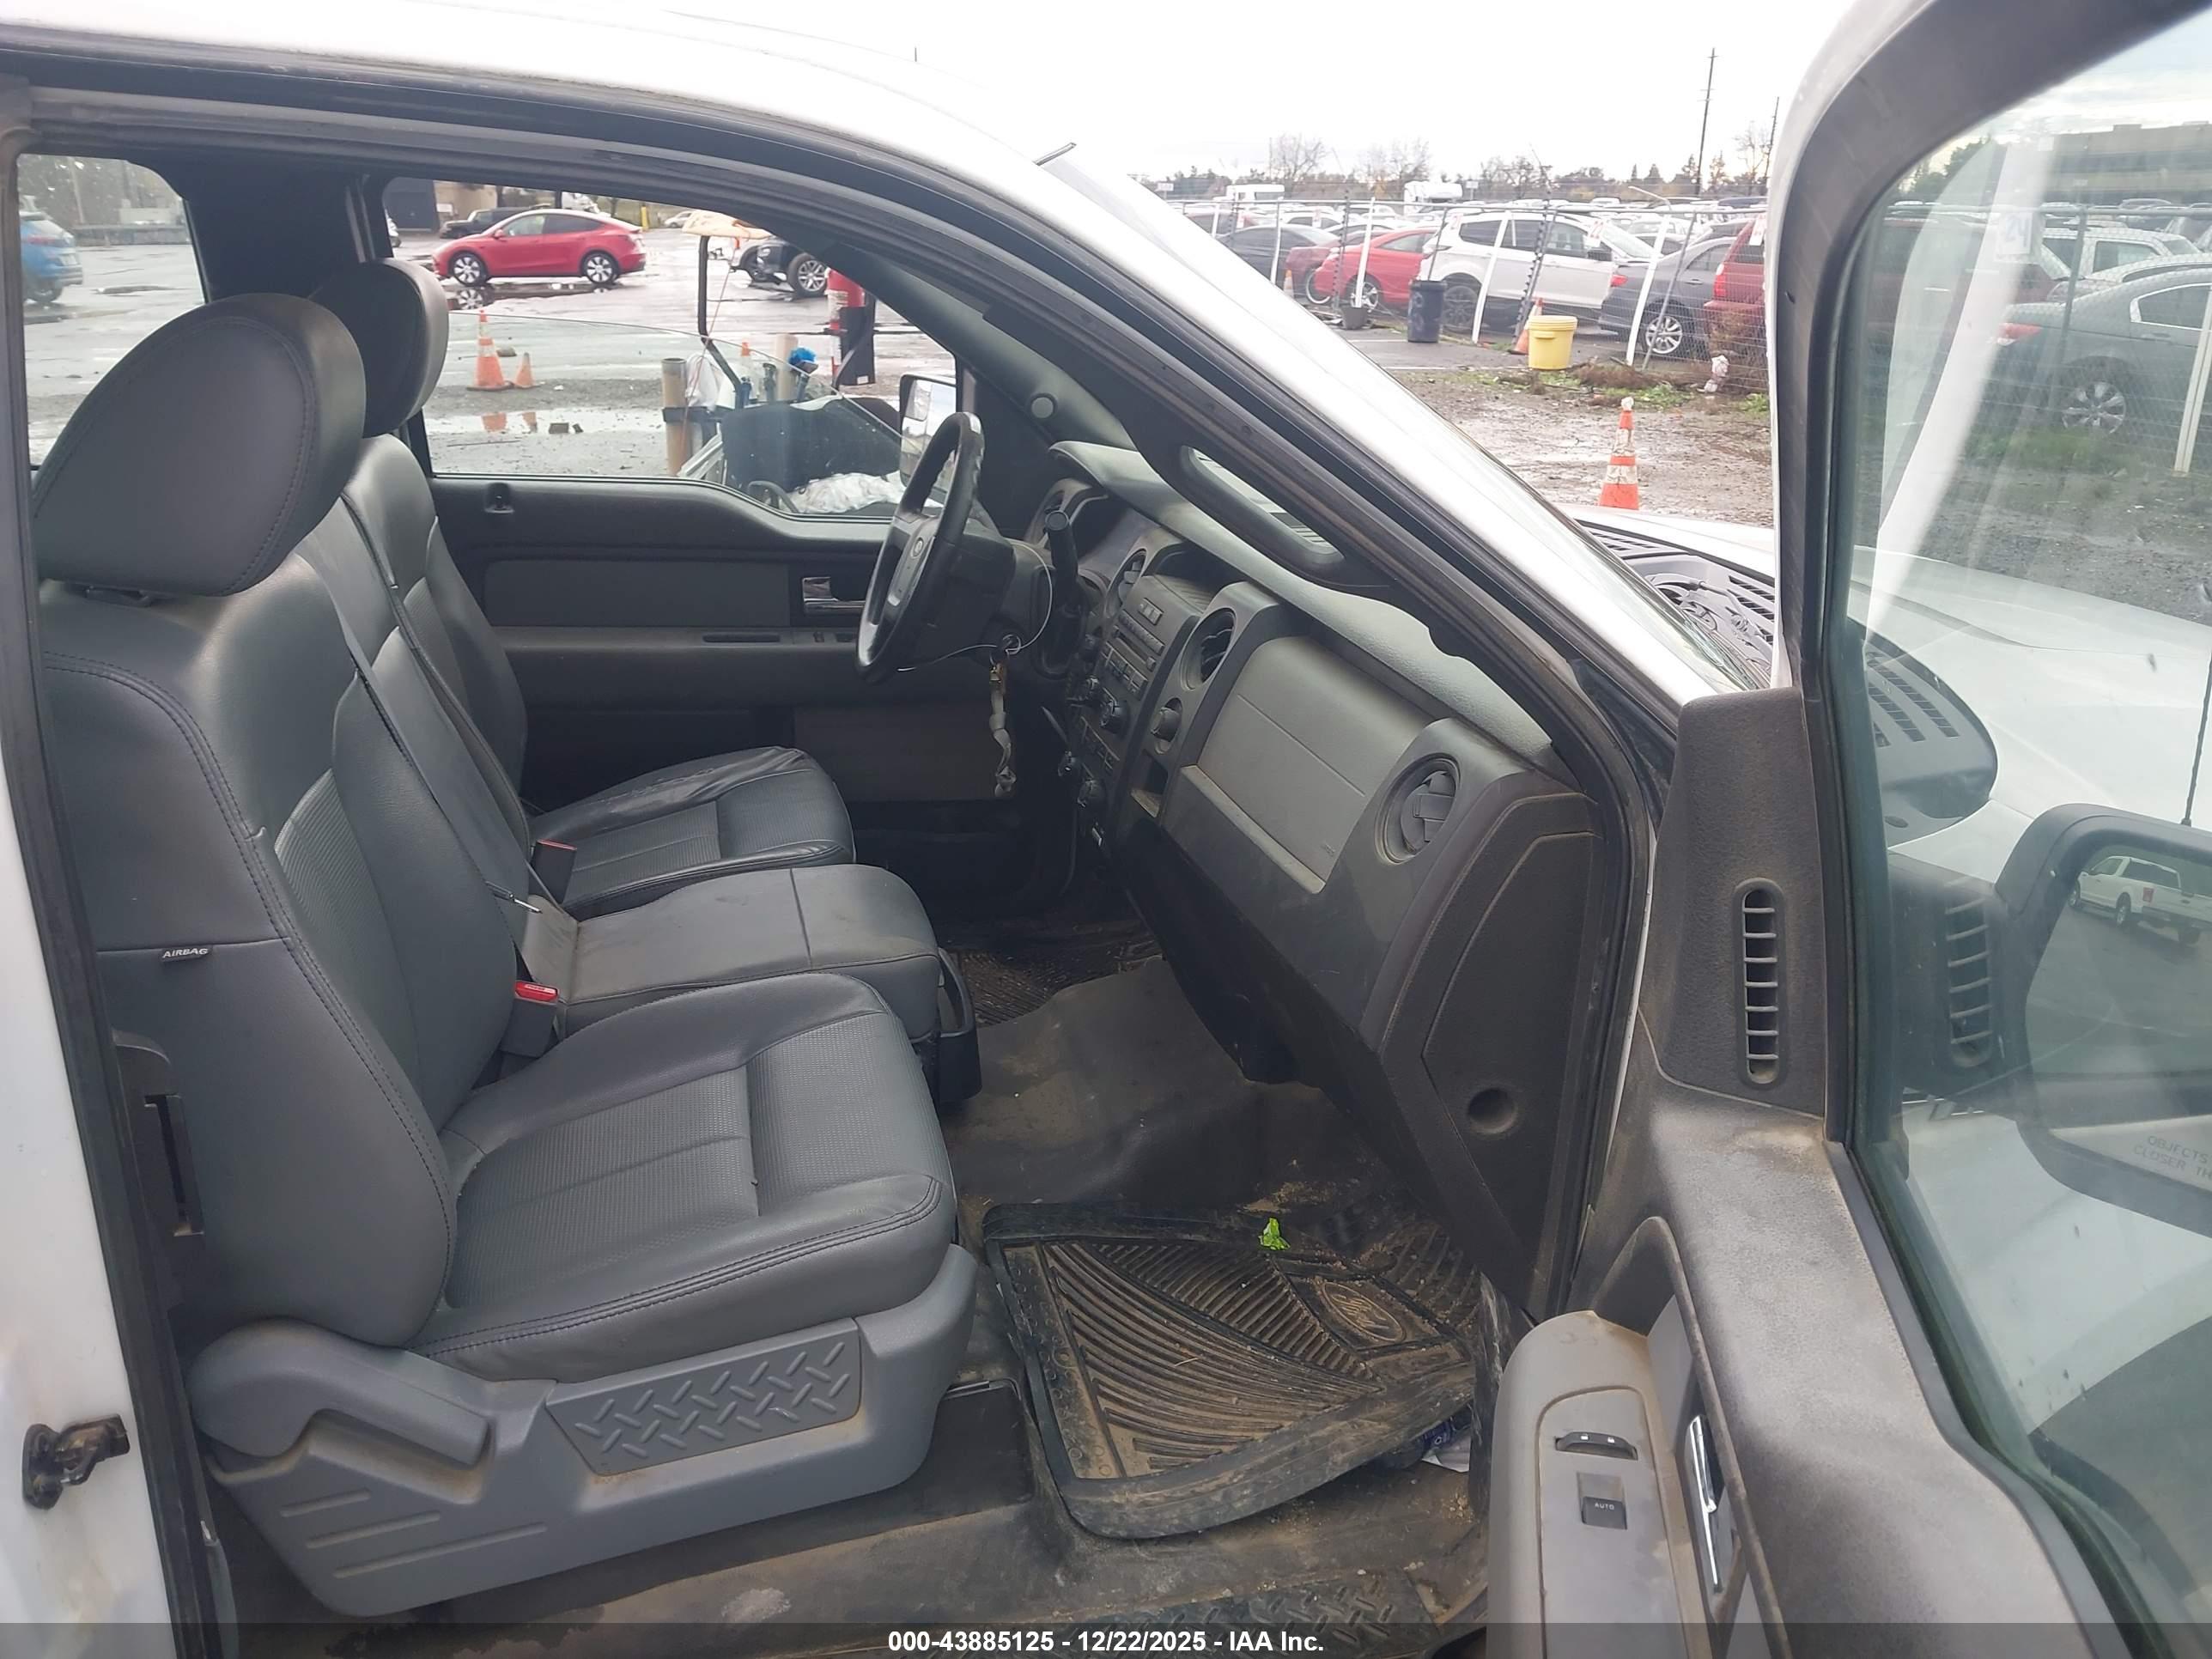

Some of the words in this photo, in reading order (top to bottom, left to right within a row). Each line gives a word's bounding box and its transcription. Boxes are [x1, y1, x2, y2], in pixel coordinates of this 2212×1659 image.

[161, 947, 209, 959] AIRBAG
[2135, 1144, 2186, 1171] CLOSER
[2148, 1134, 2209, 1164] OBJECTS
[1595, 1502, 1615, 1511] AUTO
